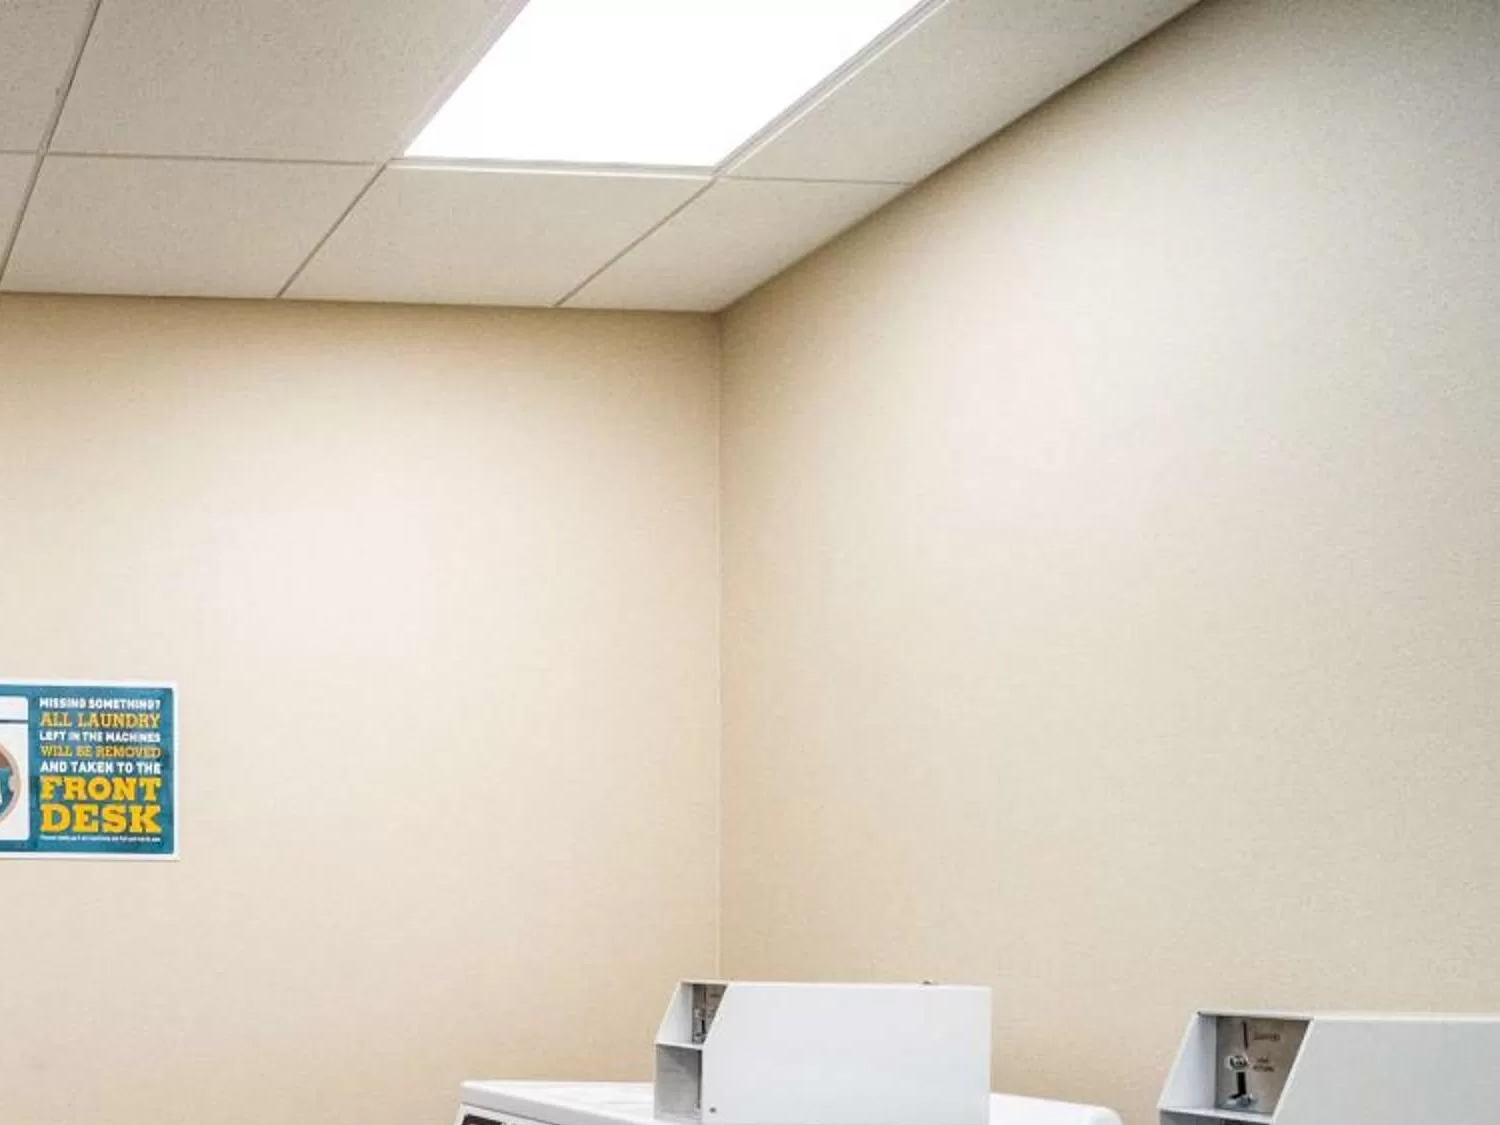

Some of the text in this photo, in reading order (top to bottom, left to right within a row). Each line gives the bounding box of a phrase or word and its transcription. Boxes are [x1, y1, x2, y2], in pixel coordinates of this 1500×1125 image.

[40, 697, 161, 709] MISSING SOMETHING?
[41, 711, 161, 730] ALL LAUNDRY
[40, 731, 66, 741] LEFT
[68, 732, 80, 741] IN
[82, 731, 103, 742] THE
[41, 745, 161, 759] WILL BE REMOVED
[40, 761, 162, 774] AND TAKEN TO THE
[40, 776, 161, 801] FRONT
[40, 803, 161, 833] DESK
